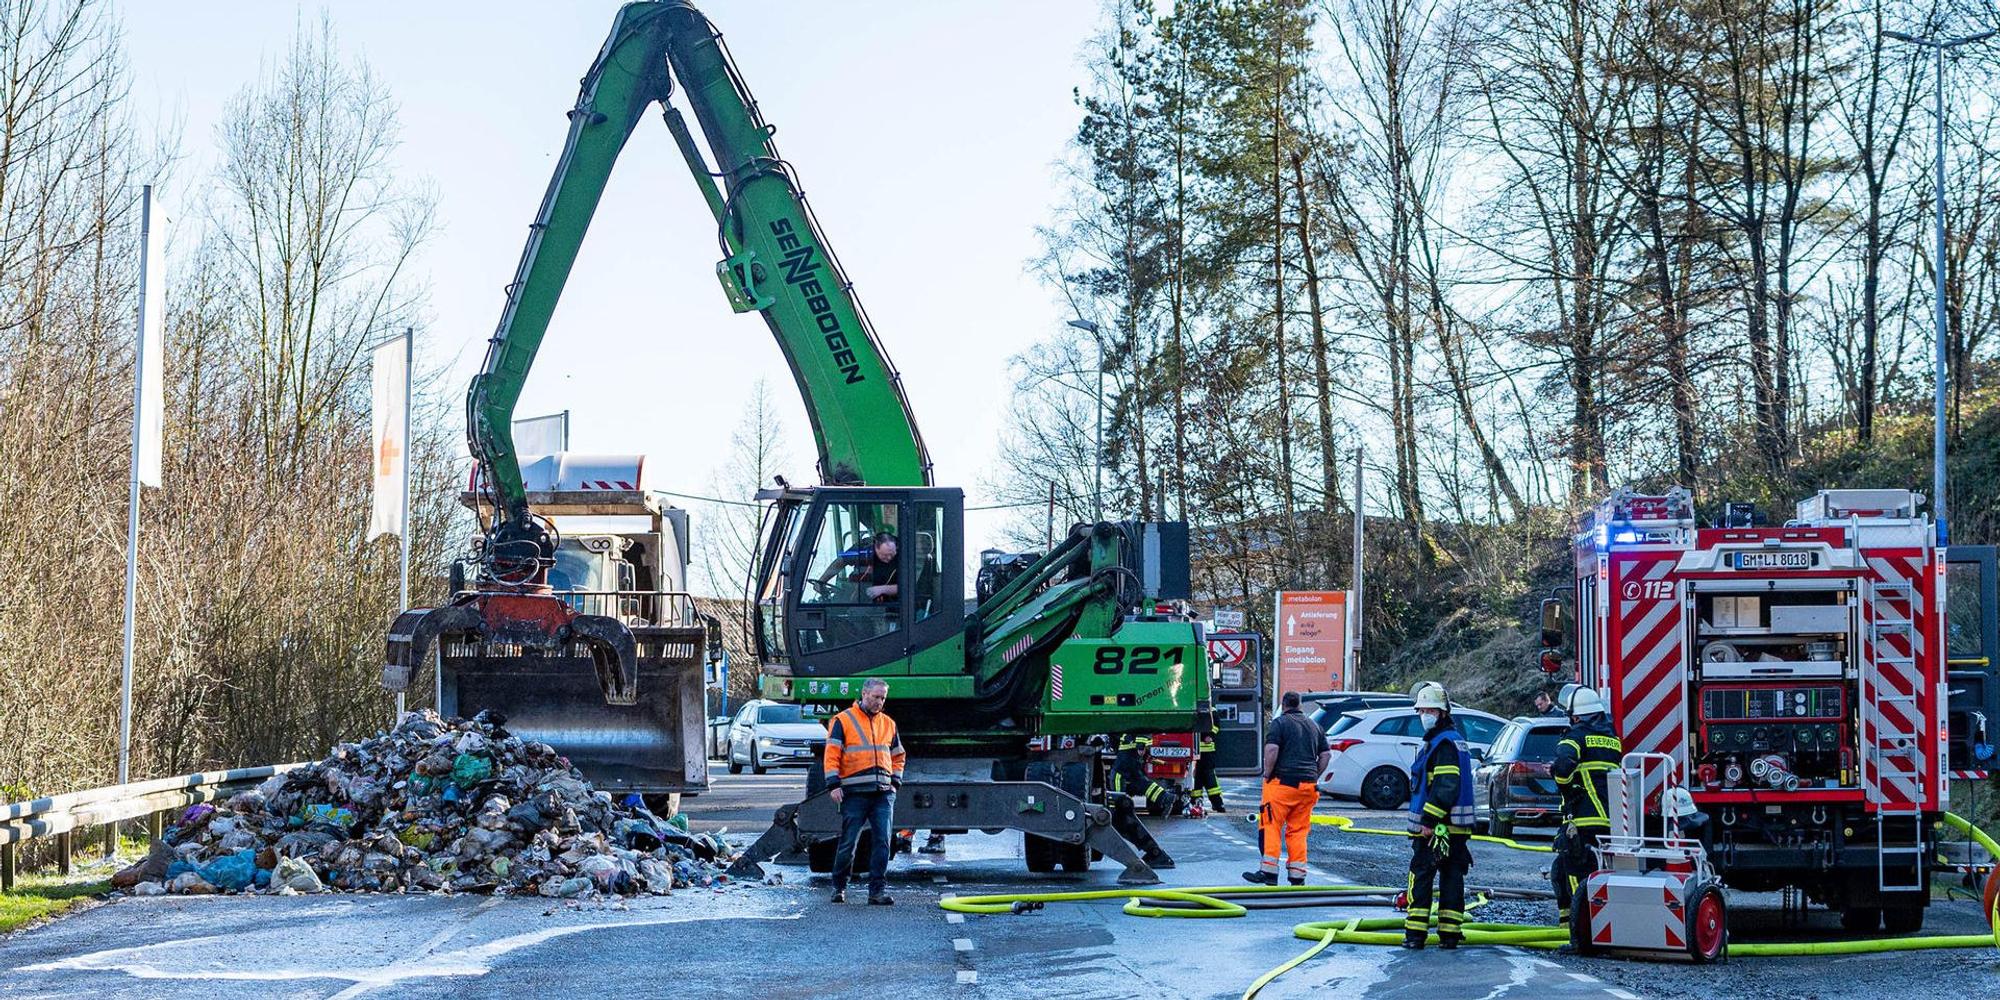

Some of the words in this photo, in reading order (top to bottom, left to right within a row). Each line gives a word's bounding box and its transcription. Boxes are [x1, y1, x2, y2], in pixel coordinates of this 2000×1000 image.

[769, 217, 866, 385] SENNEBOGEN
[1742, 554, 1757, 566] GM
[1764, 554, 1778, 566] LI
[1780, 553, 1807, 566] 8018
[1643, 581, 1675, 600] 112
[1286, 646, 1315, 655] Eingang
[1093, 646, 1184, 675] 821
[1136, 686, 1165, 706] green
